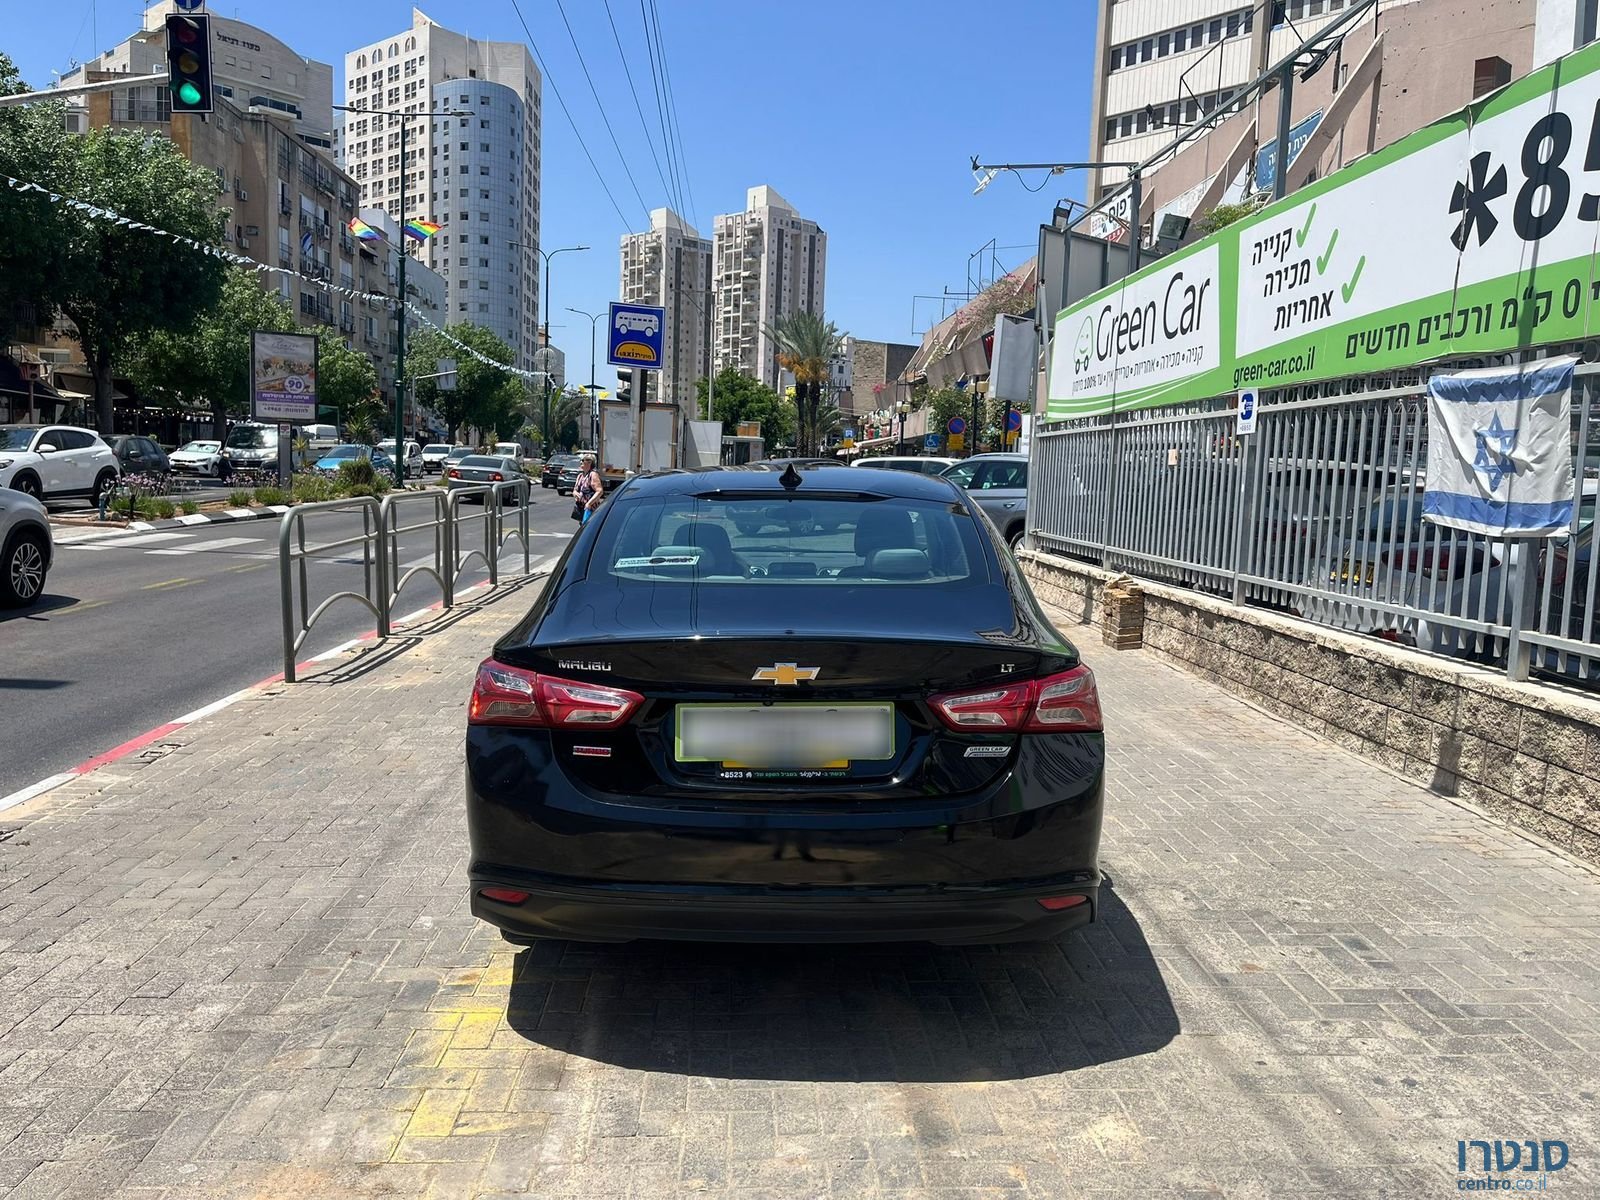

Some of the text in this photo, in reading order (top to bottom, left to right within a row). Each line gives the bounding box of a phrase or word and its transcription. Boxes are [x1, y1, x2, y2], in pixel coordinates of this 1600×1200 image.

[1252, 228, 1293, 266] קנייה
[1263, 258, 1311, 298] מכירה
[1096, 271, 1211, 362] Green Car
[1274, 290, 1334, 331] אחריות
[1562, 278, 1581, 319] 0
[1345, 321, 1410, 359] חדשים
[1417, 303, 1493, 346] ורכבים
[1133, 358, 1156, 376] אחריות
[1159, 351, 1180, 369] מכירה
[1185, 346, 1204, 366] קניה
[1233, 346, 1316, 389] green-car.co.il
[288, 379, 303, 389] 90
[558, 659, 612, 672] MALIBU
[1001, 664, 1015, 673] LT
